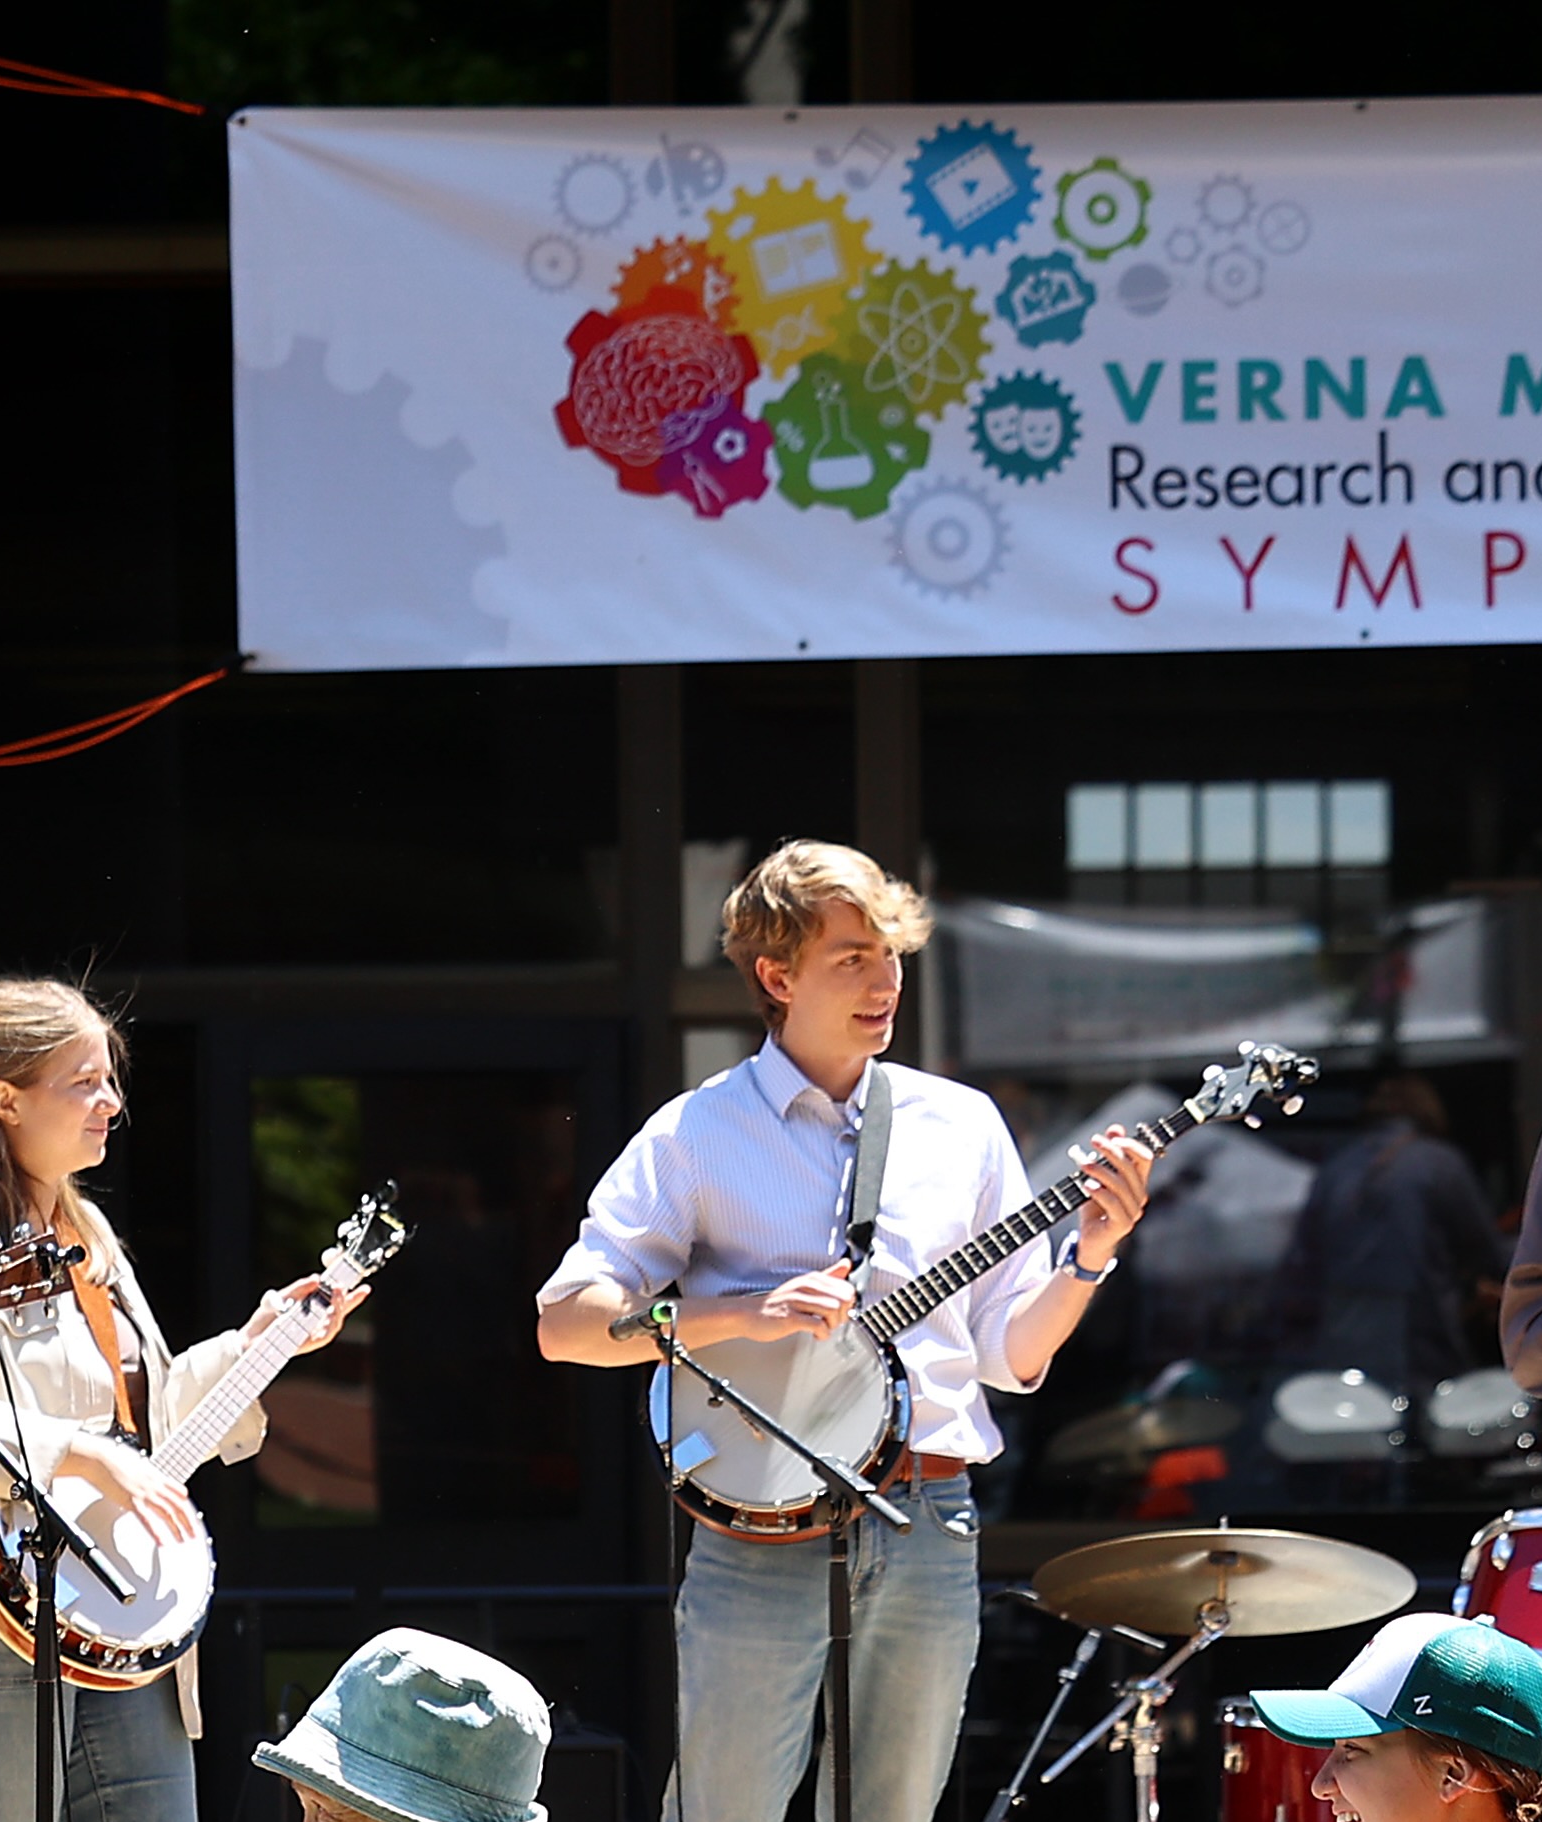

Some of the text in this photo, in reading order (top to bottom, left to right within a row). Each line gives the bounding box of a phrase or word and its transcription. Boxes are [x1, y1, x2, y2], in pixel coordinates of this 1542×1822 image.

[1103, 355, 1447, 425] VERNA
[1110, 428, 1415, 510] Research
[1414, 1695, 1433, 1715] Z
